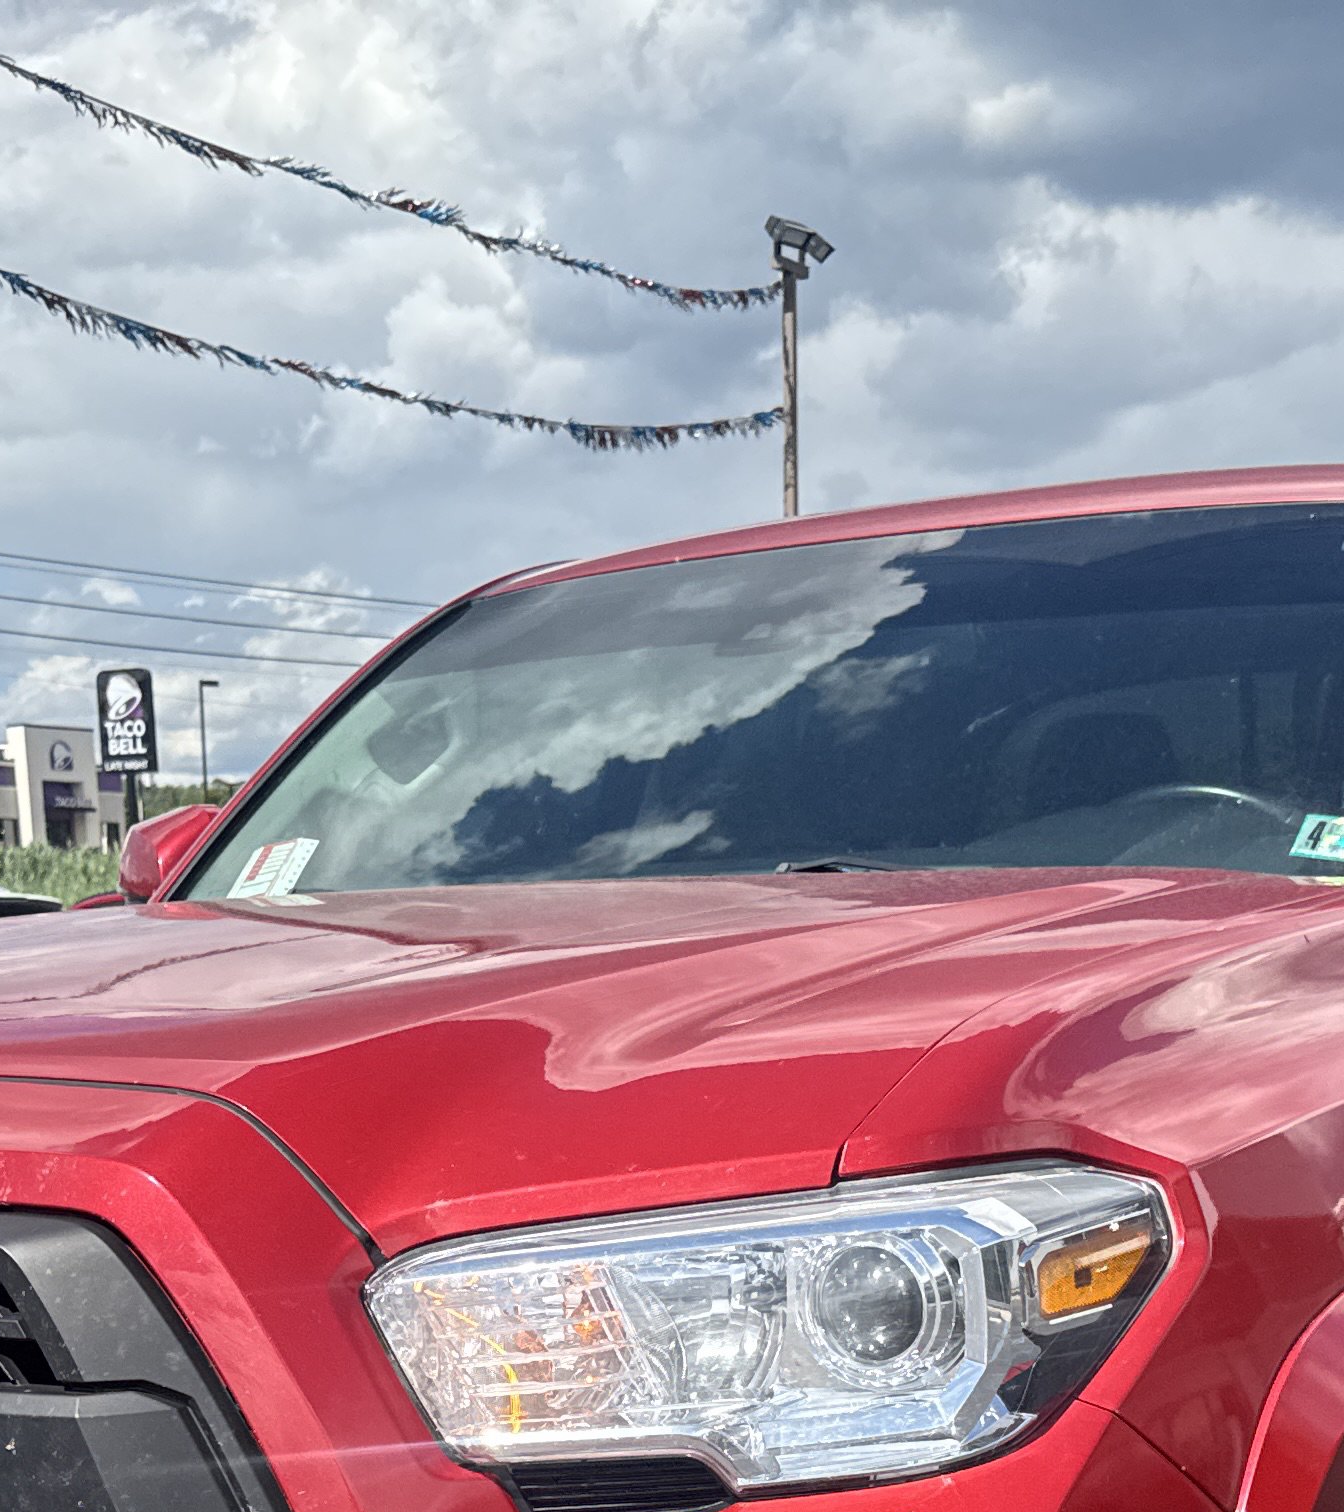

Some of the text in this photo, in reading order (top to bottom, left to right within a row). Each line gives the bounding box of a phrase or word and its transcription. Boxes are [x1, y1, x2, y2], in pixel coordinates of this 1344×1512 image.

[104, 719, 146, 739] TACO
[108, 738, 147, 756] BELL
[1307, 821, 1327, 850] 4
